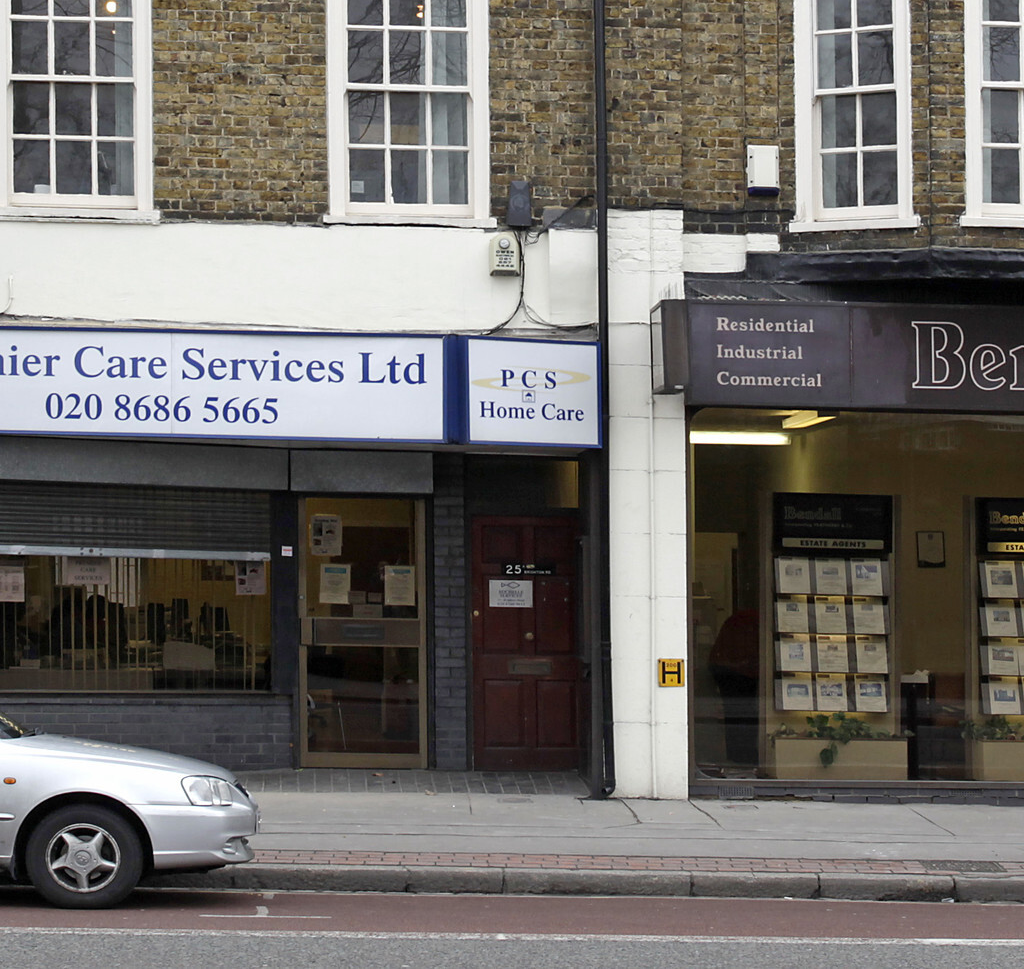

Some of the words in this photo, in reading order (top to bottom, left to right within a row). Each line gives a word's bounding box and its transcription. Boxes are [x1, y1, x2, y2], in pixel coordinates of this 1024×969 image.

[716, 317, 815, 333] Residential
[716, 344, 803, 360] Industrial
[74, 345, 167, 379] Care
[182, 347, 345, 383] Services
[358, 352, 427, 385] Ltd
[716, 371, 822, 387] Commercial
[45, 392, 103, 420] 020
[114, 394, 191, 423] 8686
[202, 396, 279, 424] 5665
[480, 401, 535, 420] Home
[541, 402, 584, 421] Care
[784, 506, 841, 519] Bendall
[832, 540, 866, 548] AGENTS
[662, 661, 681, 684] H
